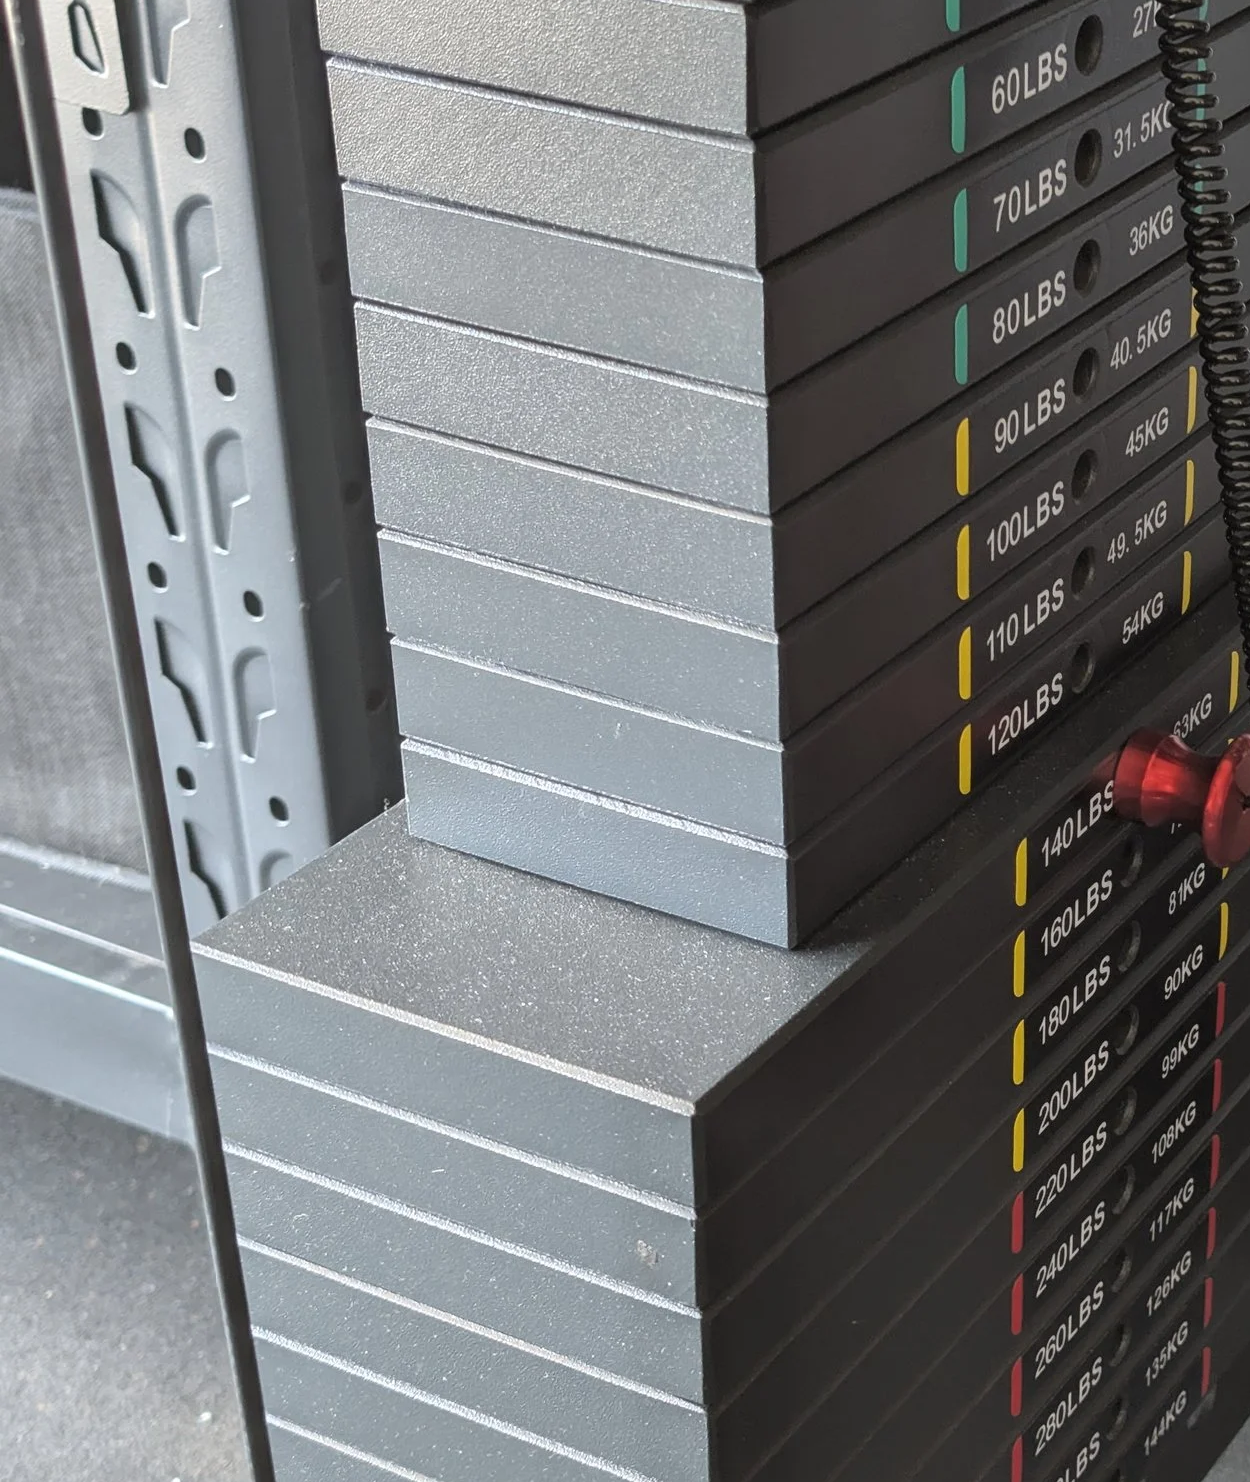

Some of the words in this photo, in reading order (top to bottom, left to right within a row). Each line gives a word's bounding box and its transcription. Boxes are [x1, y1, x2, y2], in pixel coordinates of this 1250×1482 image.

[991, 42, 1068, 114] 60LBS
[993, 158, 1067, 233] 70LBS
[992, 270, 1066, 344] 80LBS
[1129, 204, 1174, 256] 36KG
[986, 480, 1065, 562] 100LBS
[1125, 406, 1169, 457] 45KG
[994, 378, 1066, 454] 90LBS
[986, 577, 1065, 662] 110LBS
[987, 672, 1063, 755] 120LBS
[1122, 591, 1164, 645] 54KG
[1041, 780, 1114, 867] 140LBS
[1173, 693, 1212, 739] 63KG
[1038, 955, 1111, 1046] 180LBS
[1168, 862, 1206, 915] 81KG
[1040, 869, 1113, 957] 160LBS
[1038, 1039, 1109, 1135] 200LBS
[1164, 944, 1203, 1000] 90KG
[1034, 1122, 1108, 1218] 220LBS
[1161, 1023, 1200, 1079] 99KG
[1035, 1201, 1106, 1298] 240LBS
[1151, 1100, 1197, 1164] 108KG
[1034, 1280, 1104, 1379] 260LBS
[1149, 1177, 1195, 1242] 117KG
[1034, 1356, 1103, 1456] 280LBS
[1146, 1250, 1192, 1316] 126KG
[1145, 1320, 1189, 1387] 135KG
[1144, 1390, 1187, 1456] 144KG
